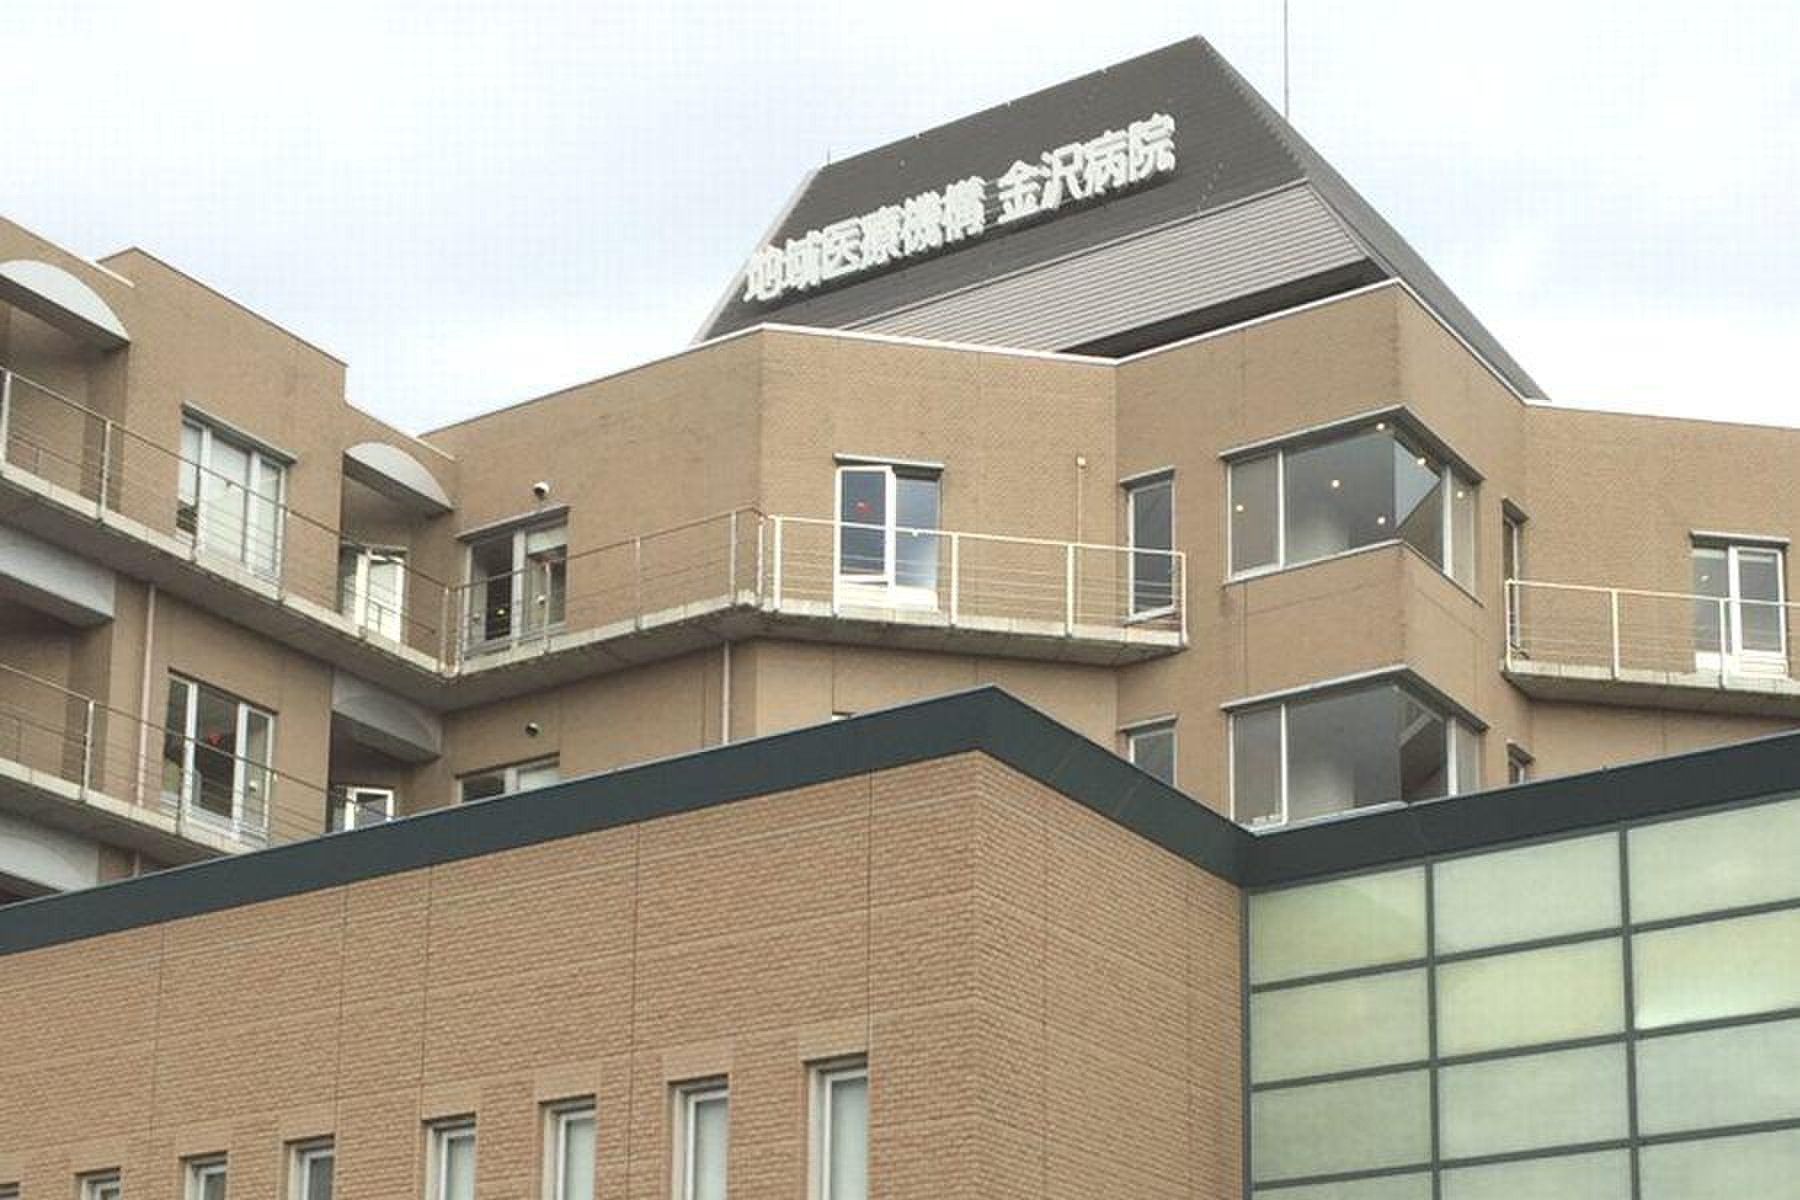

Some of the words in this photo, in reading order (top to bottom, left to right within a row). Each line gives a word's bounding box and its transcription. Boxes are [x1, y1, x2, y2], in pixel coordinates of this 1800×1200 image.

[743, 175, 987, 302] 地域医療機構
[998, 112, 1177, 224] 金沢病院
